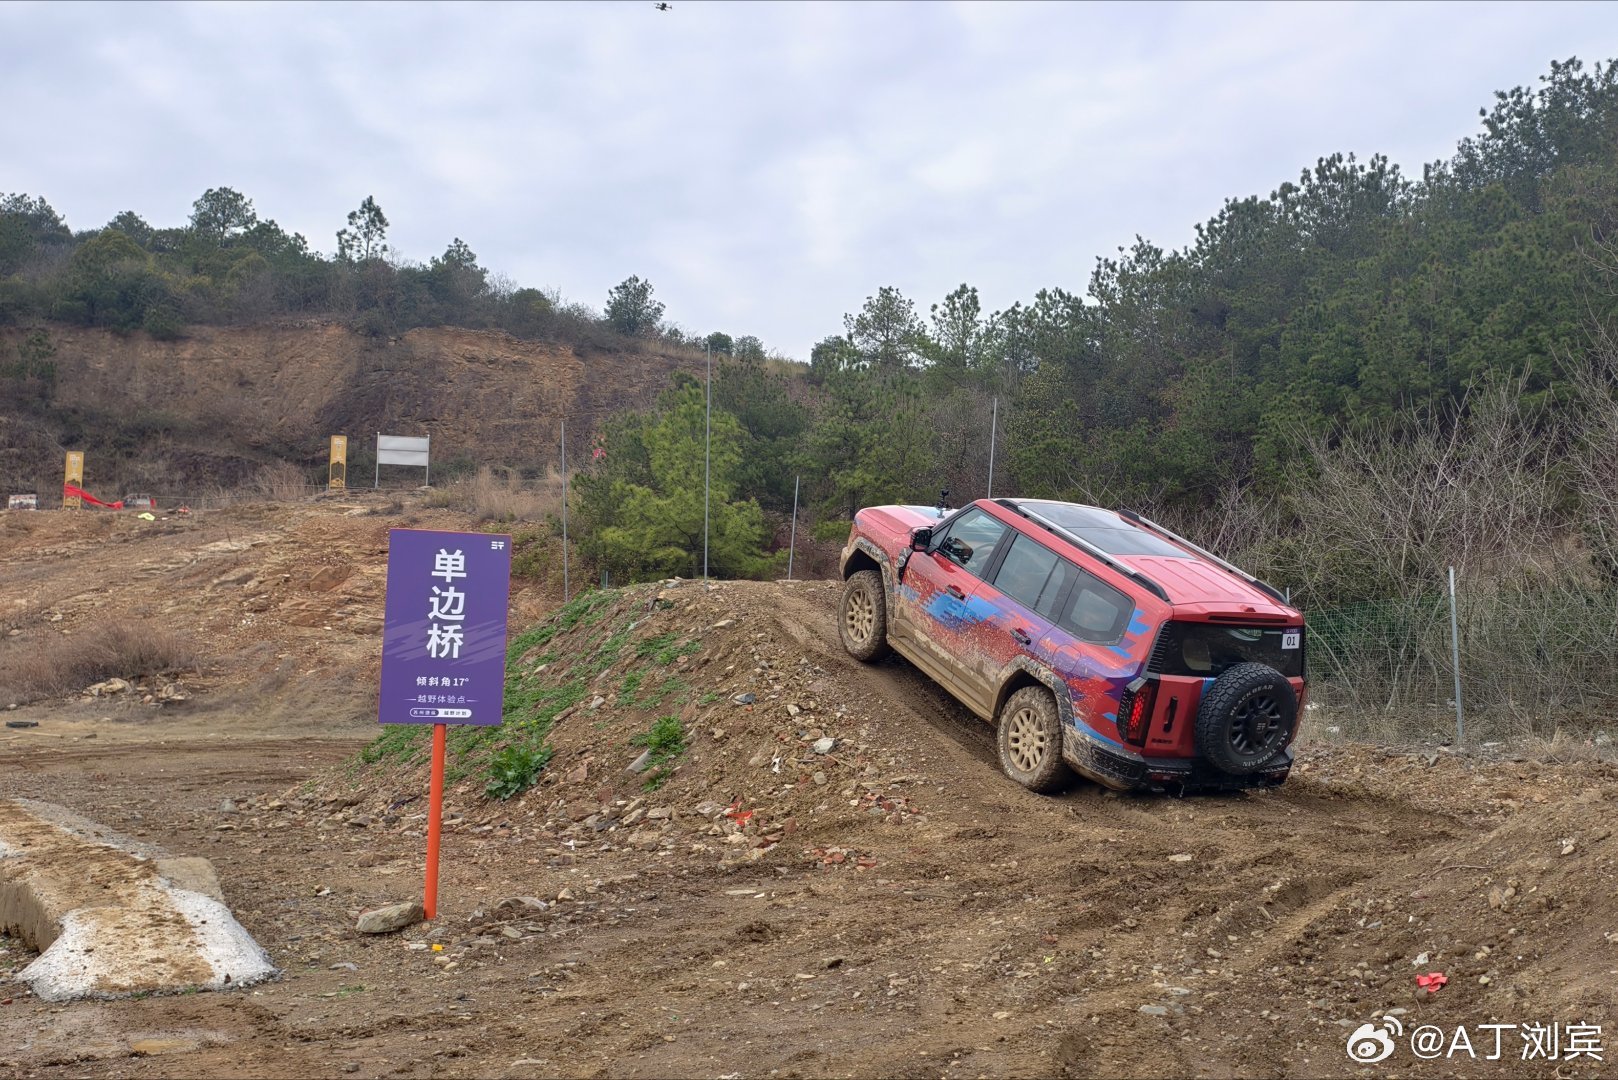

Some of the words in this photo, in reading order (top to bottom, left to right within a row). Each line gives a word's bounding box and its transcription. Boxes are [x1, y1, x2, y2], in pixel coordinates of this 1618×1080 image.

[426, 548, 467, 659] 单边桥
[1286, 636, 1296, 646] 01
[417, 694, 466, 704] 越野体验点
[1242, 748, 1277, 767] TERRAIN
